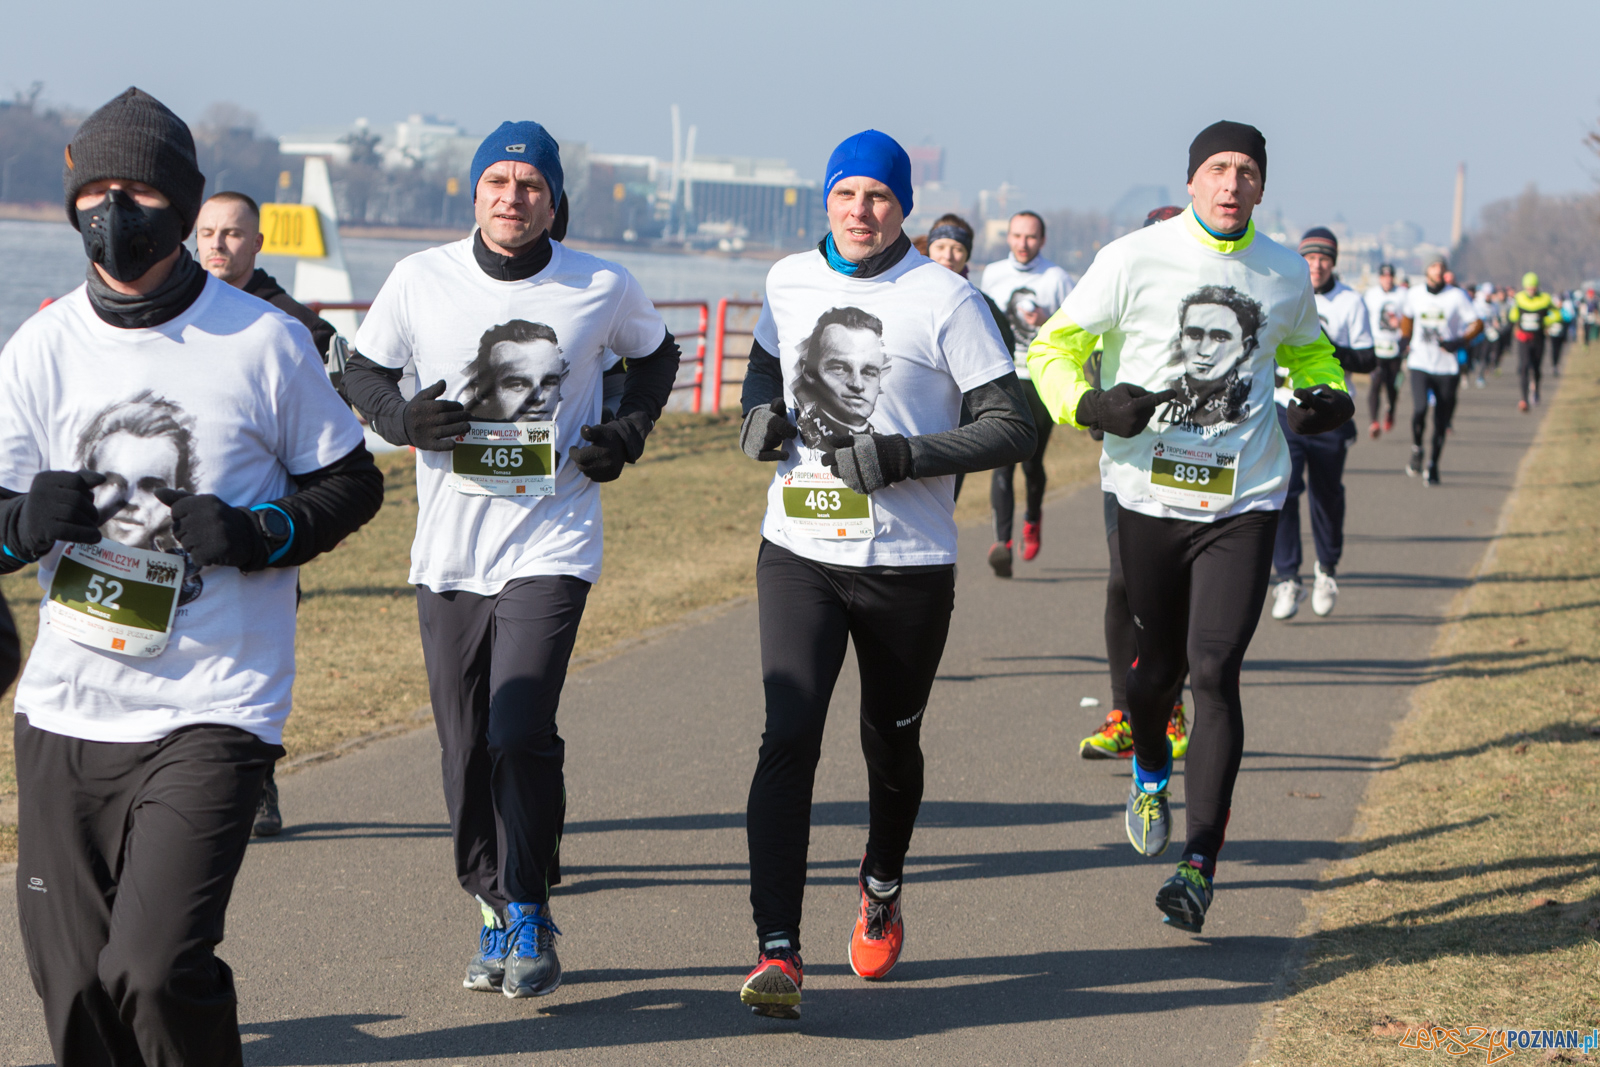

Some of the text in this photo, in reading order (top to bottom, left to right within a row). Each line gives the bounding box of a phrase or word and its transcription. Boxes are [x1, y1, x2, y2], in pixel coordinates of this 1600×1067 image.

[269, 210, 304, 247] 200
[480, 447, 524, 468] 465
[1173, 463, 1211, 485] 893
[804, 490, 842, 511] 463
[85, 573, 124, 611] 52
[86, 605, 112, 620] Tomasz
[896, 718, 912, 728] RUN
